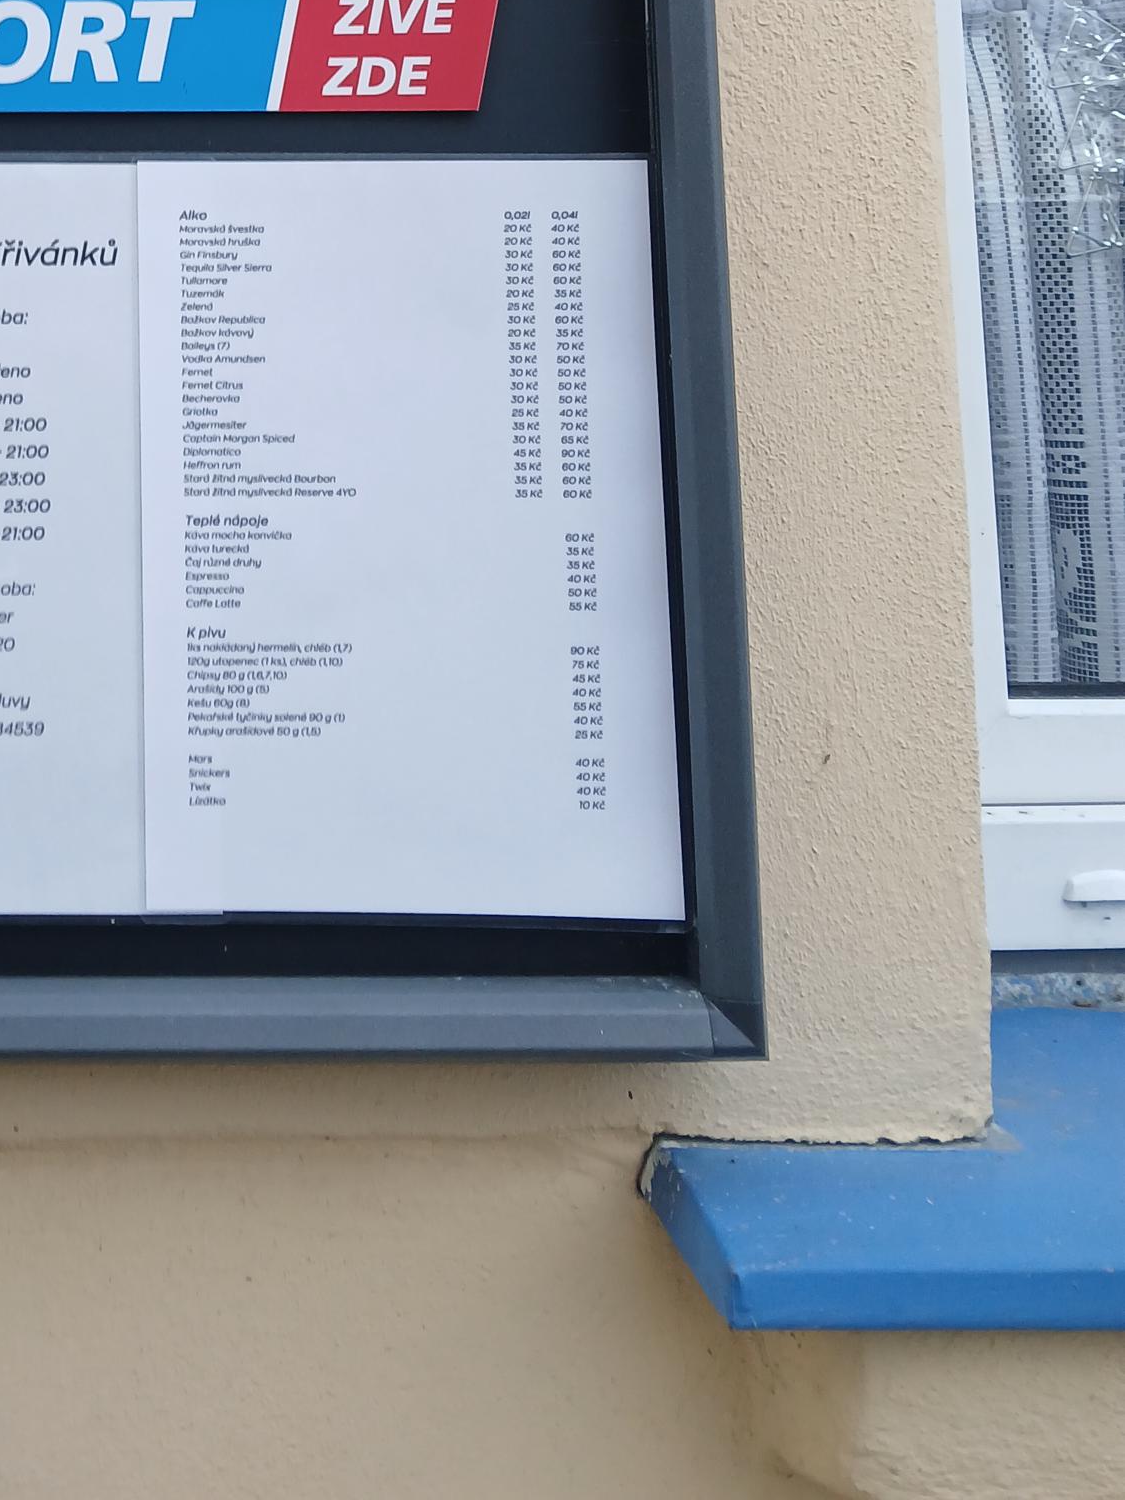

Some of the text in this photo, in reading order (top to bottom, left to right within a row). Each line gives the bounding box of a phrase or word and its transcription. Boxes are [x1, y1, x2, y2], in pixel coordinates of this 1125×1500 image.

[320, 52, 431, 99] ZDE
[179, 210, 207, 221] Alko
[504, 211, 531, 221] 0,02l
[551, 211, 578, 221] 0,04l
[179, 224, 265, 233] Moravská švestka
[503, 224, 532, 233] 20 Kč
[551, 224, 579, 233] 40 Kč
[179, 237, 260, 246] Moravská hruška
[504, 237, 533, 246] 20 Kč
[552, 236, 580, 245] 40 Kč
[180, 250, 238, 260] Gin Finsbury
[505, 250, 532, 259] 30 Kč
[552, 250, 581, 259] 60 Kč
[181, 263, 272, 273] Tequila Silver Sierra
[181, 276, 228, 285] Tullamore
[218, 315, 266, 325] Republica
[182, 354, 266, 364] Vodka Amundsen
[182, 368, 213, 377] Fernet
[182, 380, 243, 390] Fernet Citrus
[182, 394, 240, 403] Becherovka
[182, 408, 218, 416] Griotka
[3, 418, 47, 432] 21:00
[183, 434, 295, 444] Captain Morgan Spiced
[6, 445, 49, 459] 21:00
[183, 447, 241, 457] Diplomatico
[183, 460, 241, 470] Heffron rum
[4, 499, 51, 513] 23:00
[186, 514, 269, 529] Teplé nápoje
[1, 526, 45, 541] 21:00
[185, 571, 230, 581] Espresso
[186, 585, 245, 595] Cappuccino
[186, 598, 241, 608] Caffe Latte
[198, 626, 226, 640] pivu
[188, 754, 212, 764] Mars
[575, 758, 605, 768] 40 Kč
[189, 768, 230, 778] Snickers
[190, 782, 211, 791] Twix
[579, 800, 605, 810] 10 Kč
